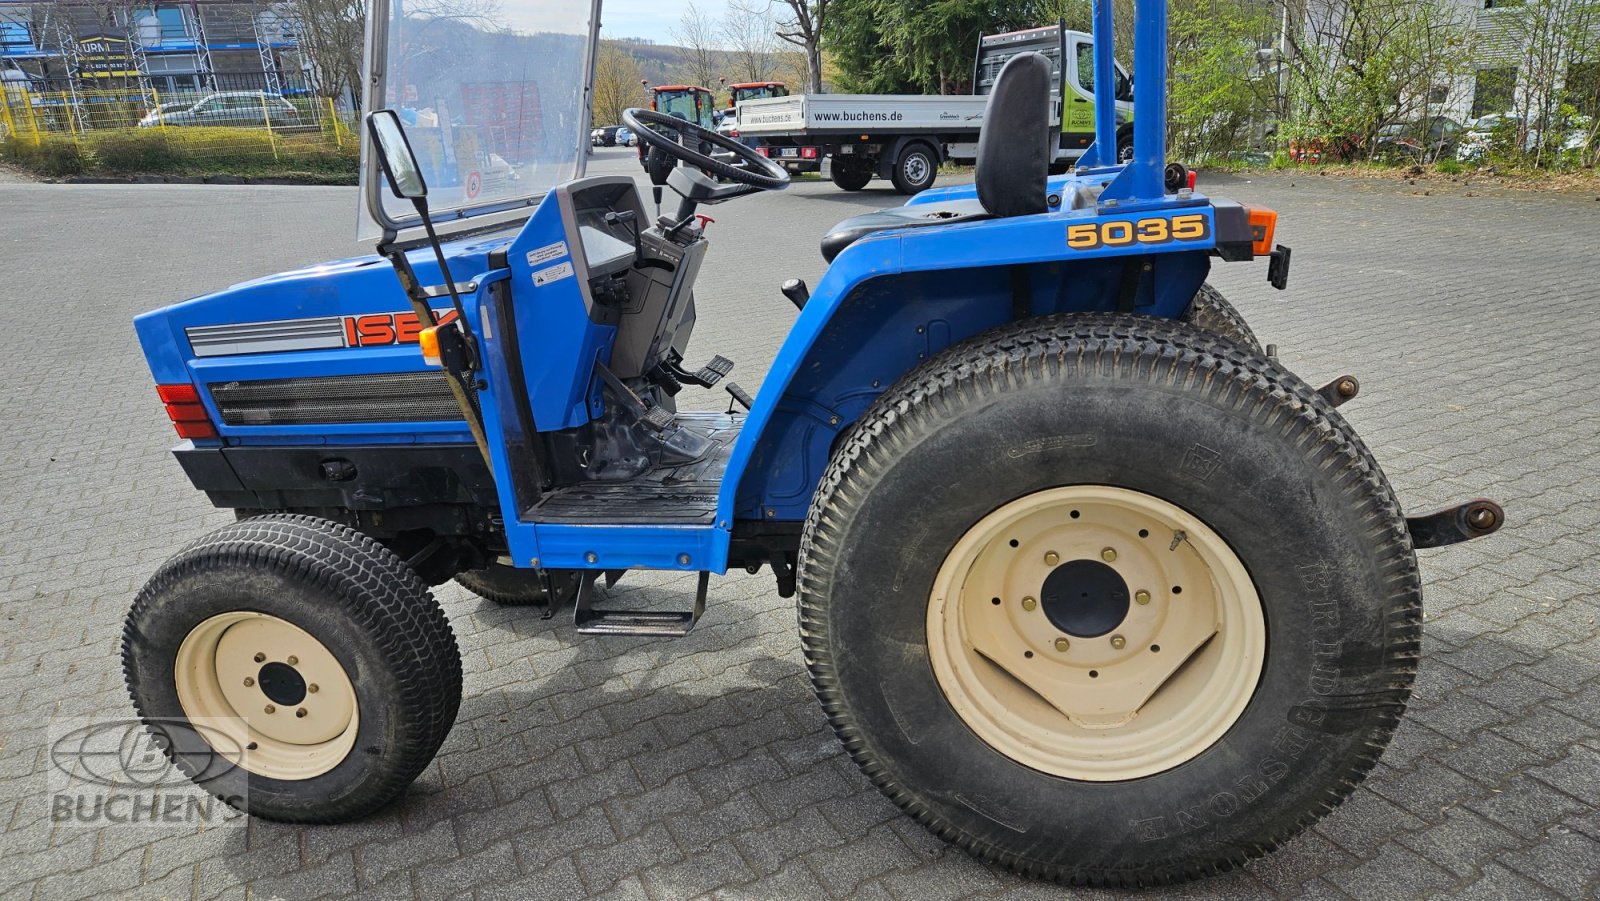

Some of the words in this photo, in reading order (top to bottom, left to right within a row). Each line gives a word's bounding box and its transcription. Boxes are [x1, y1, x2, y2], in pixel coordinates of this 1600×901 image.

[814, 111, 903, 122] www.buchens.de
[1067, 214, 1209, 249] 5035
[1135, 559, 1343, 842] BRIDGESTONE
